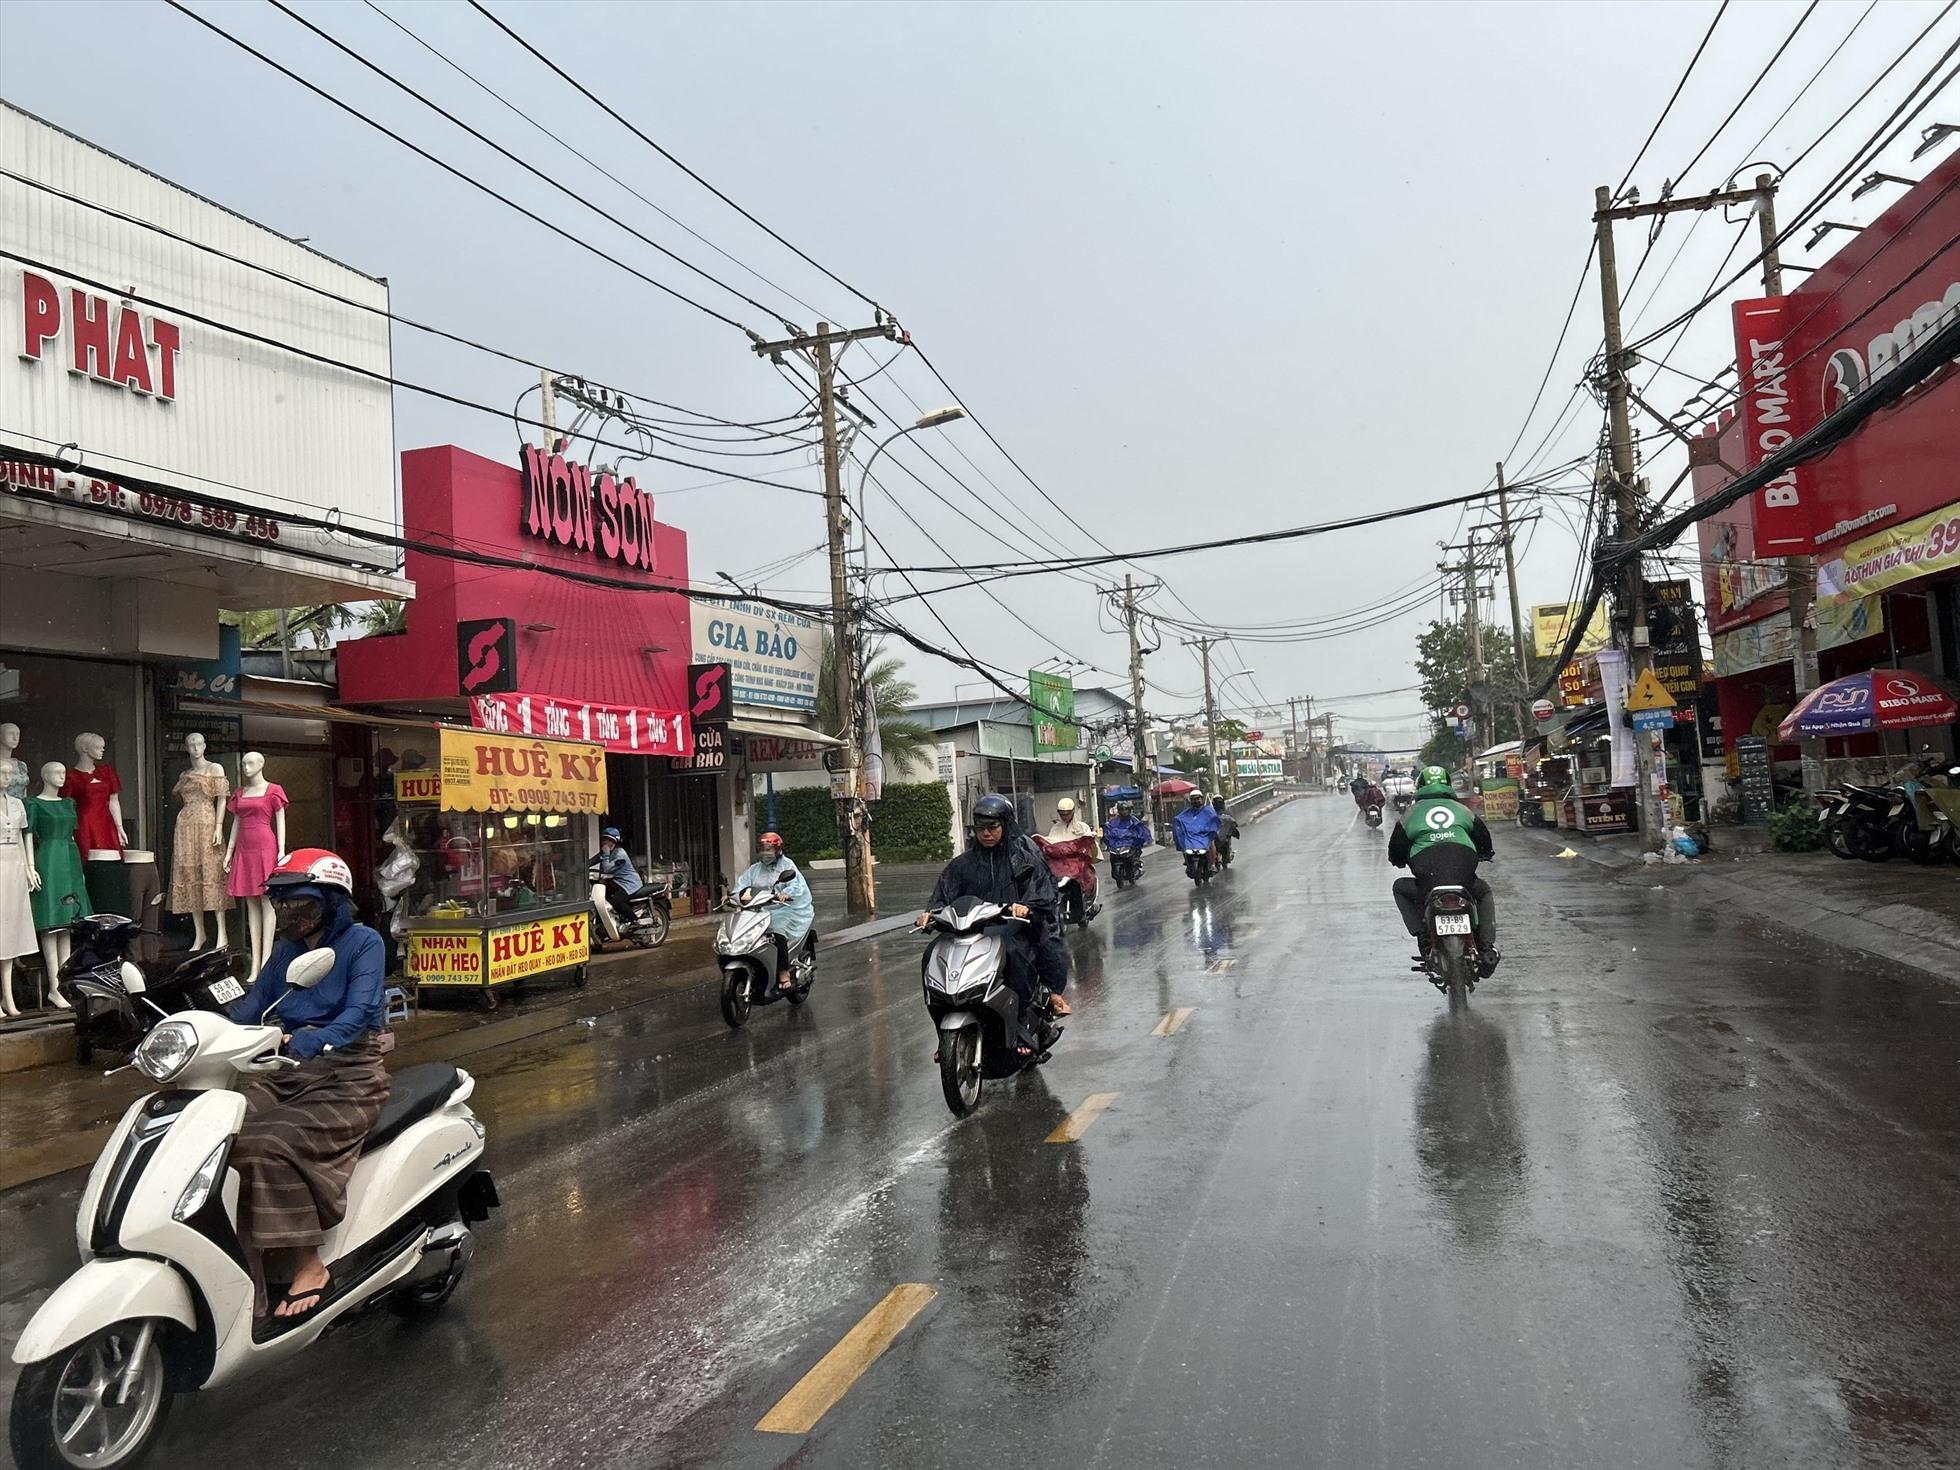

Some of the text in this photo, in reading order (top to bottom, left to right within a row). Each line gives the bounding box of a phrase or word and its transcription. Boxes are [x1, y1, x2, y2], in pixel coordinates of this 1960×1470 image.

[20, 270, 181, 402] PHÁT
[1749, 338, 1799, 508] BIO MART
[90, 479, 127, 510] ĐT:
[138, 490, 194, 524] 0978
[200, 506, 237, 532] 589
[245, 514, 281, 541] 456
[518, 438, 657, 573] NÓN SƠN
[729, 599, 751, 613] TNHH
[753, 605, 764, 617] DV
[766, 608, 777, 621] SX
[708, 620, 798, 660] GIA BẢO
[1879, 693, 1944, 709] BIBO MART
[577, 704, 591, 741] 1
[626, 709, 639, 749] 1
[672, 714, 683, 752] 1
[699, 726, 723, 748] CỬA
[695, 748, 724, 768] BẢO
[489, 788, 598, 808] ĐT: 0909 743 577
[1429, 831, 1456, 841] gojek
[493, 915, 586, 962] HUÊ KÝ
[411, 953, 479, 973] QUAY HEO
[518, 961, 528, 973] HEO
[545, 955, 556, 966] HEO
[569, 949, 578, 960] HEO
[447, 974, 463, 982] 743
[464, 974, 479, 982] 577
